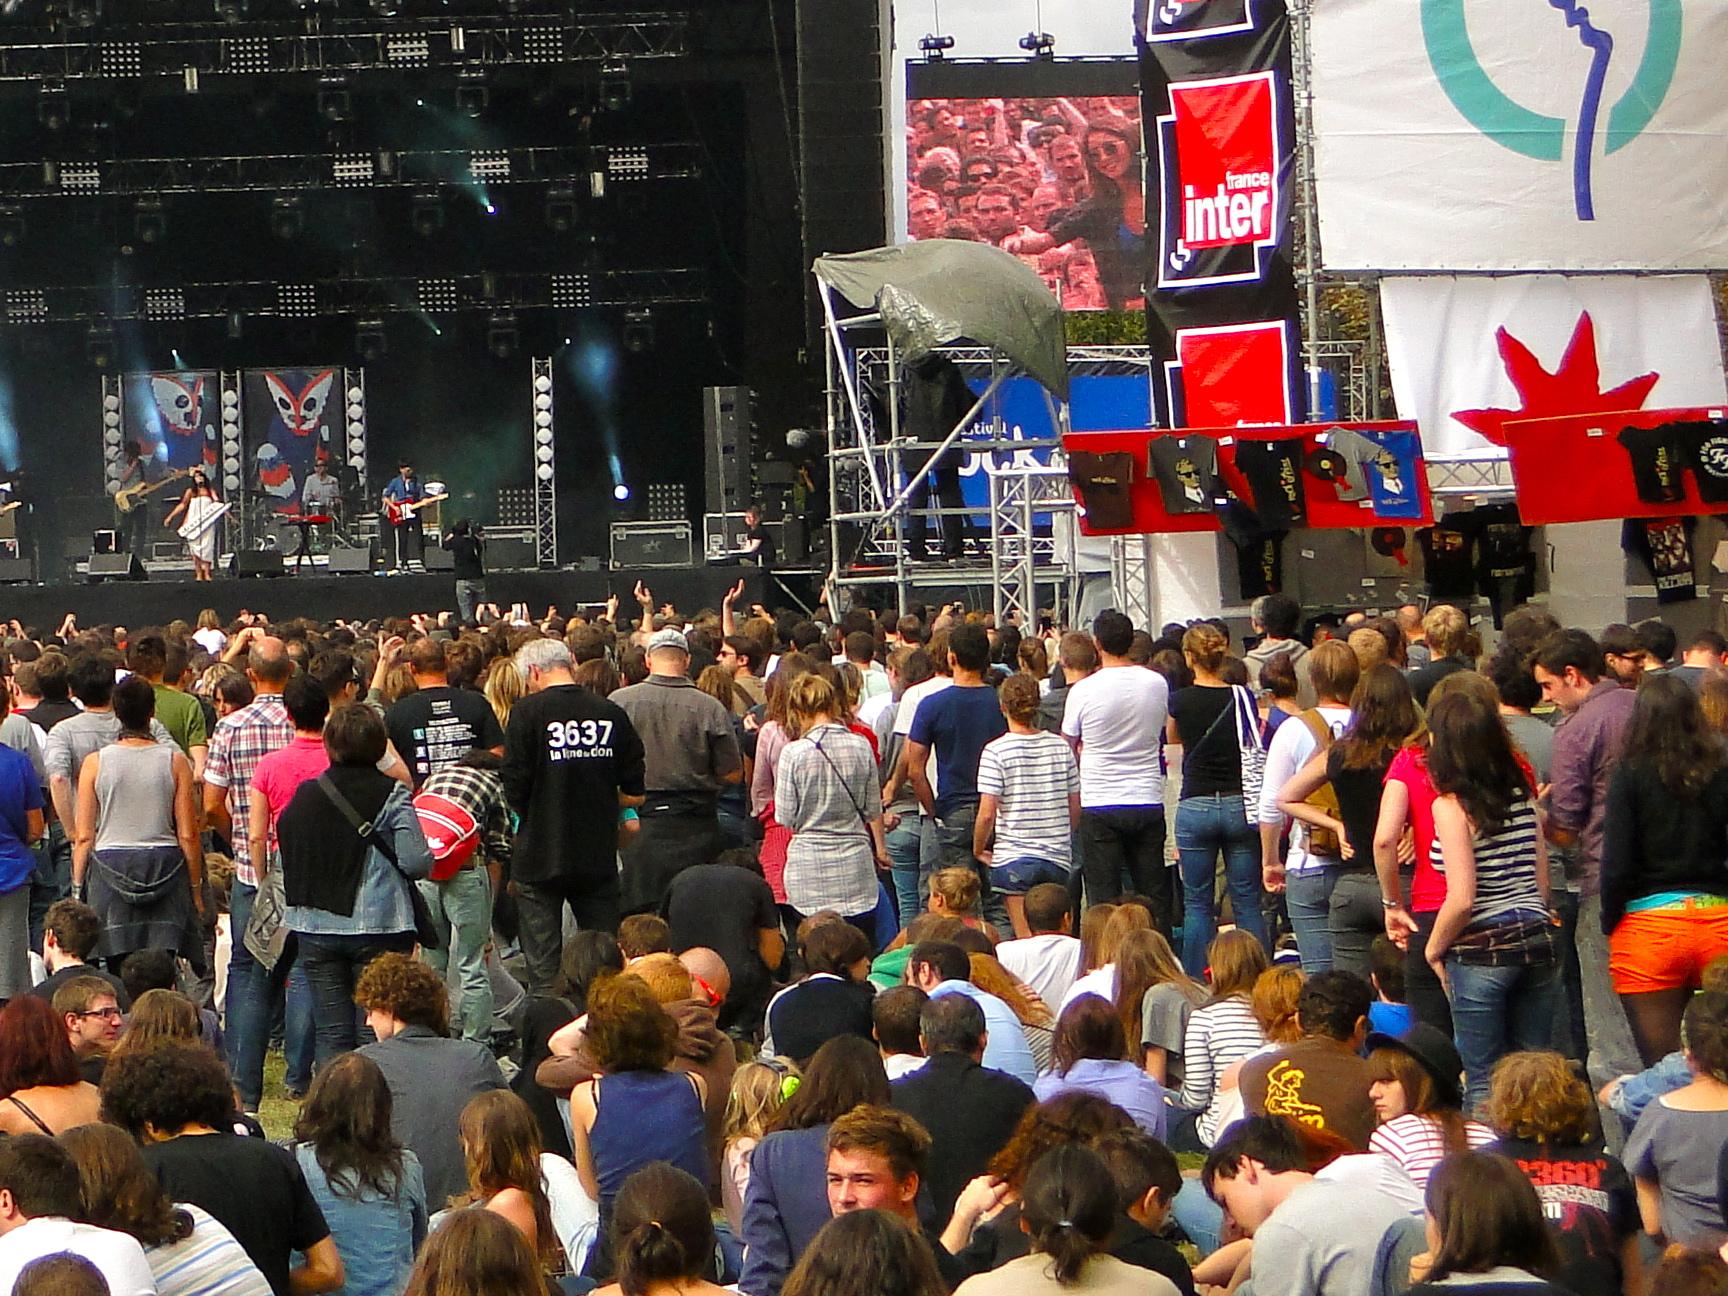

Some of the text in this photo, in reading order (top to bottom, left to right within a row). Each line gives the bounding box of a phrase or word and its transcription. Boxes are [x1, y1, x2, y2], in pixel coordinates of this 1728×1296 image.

[1225, 170, 1270, 191] france
[1184, 183, 1269, 243] inter
[547, 719, 613, 748] 3637
[590, 744, 613, 758] don
